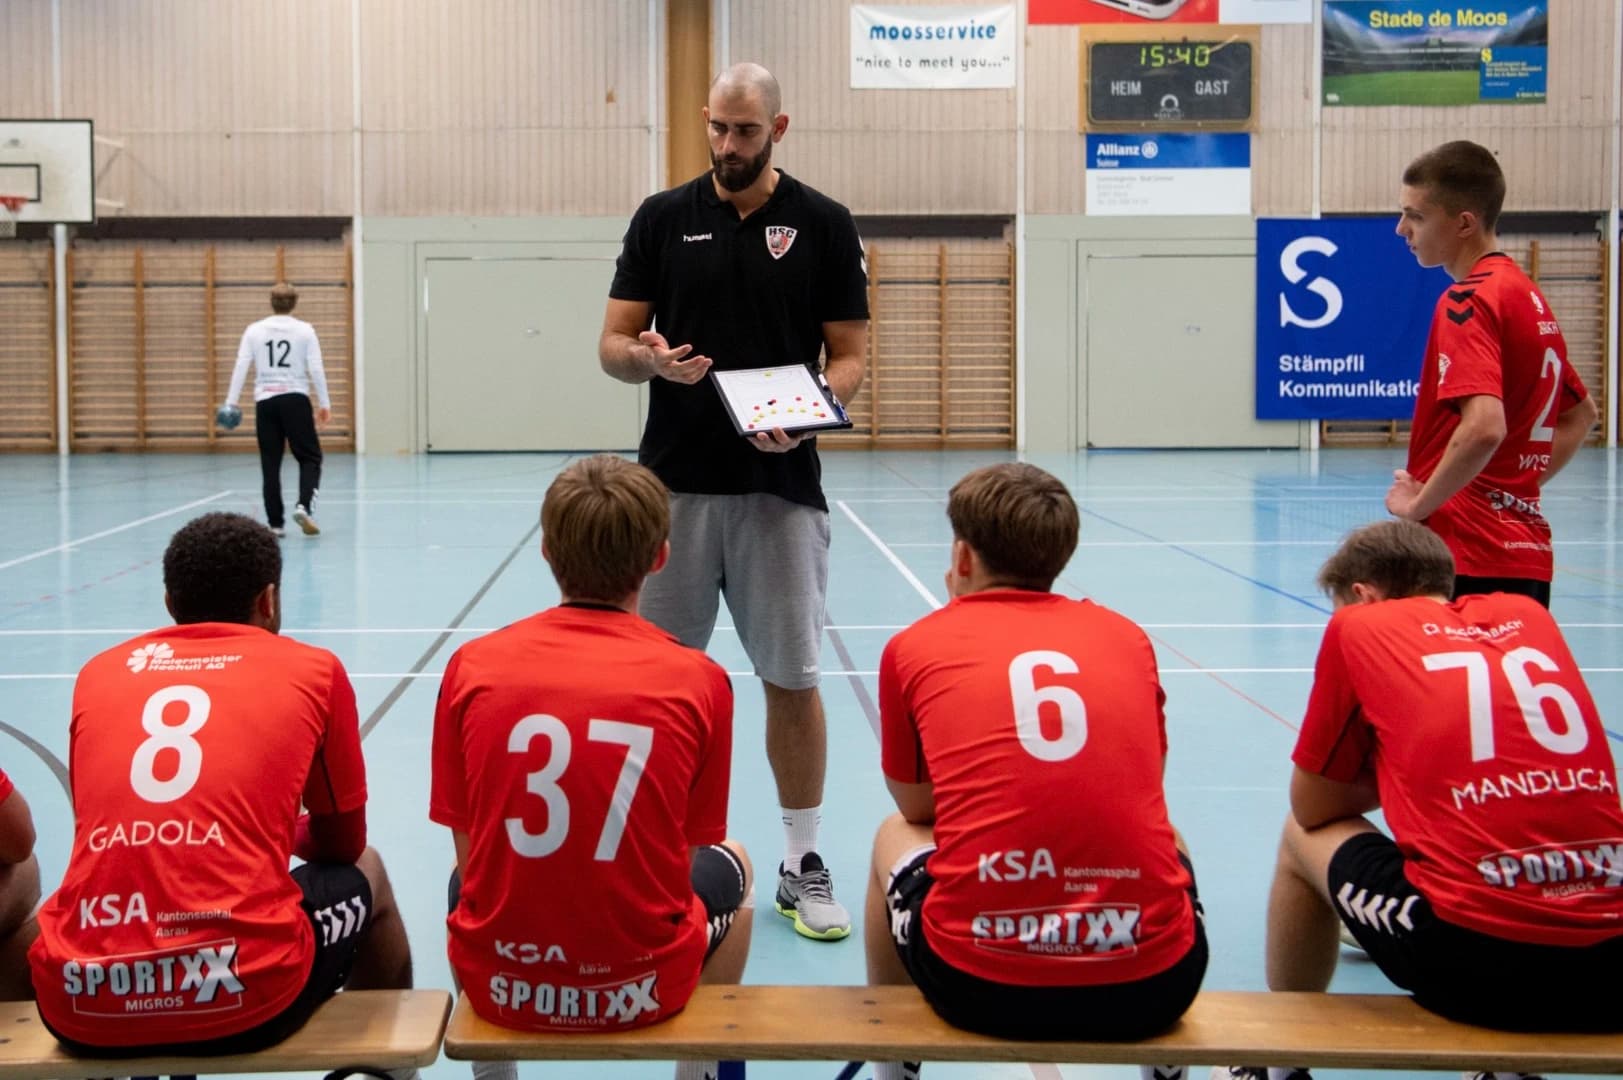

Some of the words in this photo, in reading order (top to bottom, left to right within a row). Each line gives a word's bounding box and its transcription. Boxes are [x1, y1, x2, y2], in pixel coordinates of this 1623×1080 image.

[1369, 10, 1423, 28] Stade
[1428, 10, 1453, 28] de
[1456, 9, 1508, 27] Moos
[869, 19, 997, 41] moosservice
[898, 57, 912, 69] to
[919, 55, 953, 69] meet
[1139, 45, 1210, 67] 15:40
[1110, 80, 1142, 97] HEIM
[1195, 80, 1230, 96] GAST
[1096, 143, 1140, 157] Allianz
[769, 227, 795, 239] HSC
[265, 339, 292, 368] 12
[1279, 354, 1365, 376] Stämpfli
[1529, 347, 1562, 443] 2
[206, 662, 225, 670] AG
[1008, 649, 1088, 763] 6
[1421, 645, 1589, 763] 76
[130, 684, 212, 804] 8
[504, 713, 655, 863] 37
[1451, 768, 1615, 811] MANDUCA
[88, 819, 226, 852] GADOLA
[977, 847, 1057, 883] KSA
[1063, 881, 1098, 893] Aarau
[80, 891, 149, 930] KSA
[155, 926, 189, 938] Aarau
[125, 995, 185, 1012] MIGROS
